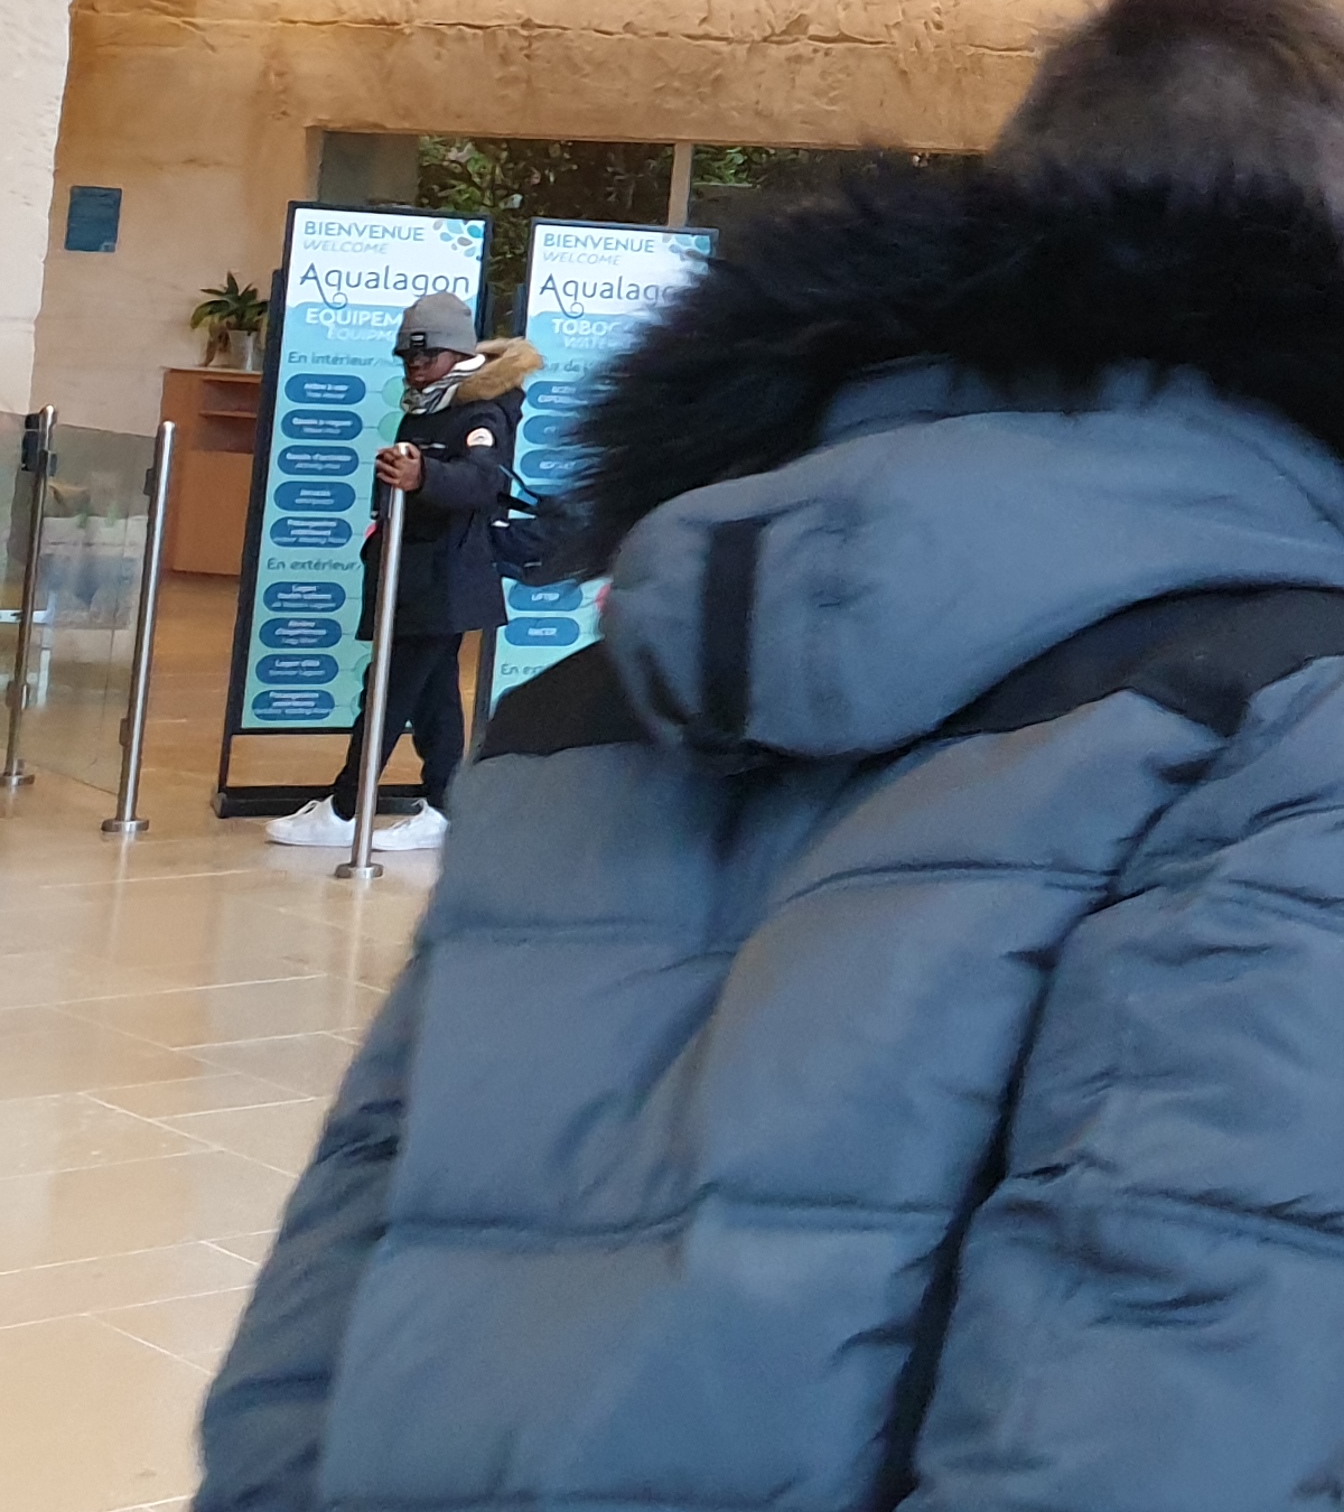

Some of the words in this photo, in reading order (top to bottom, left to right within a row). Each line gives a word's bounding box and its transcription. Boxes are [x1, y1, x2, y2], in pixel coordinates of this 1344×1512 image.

[303, 220, 425, 241] BIENVENUE
[303, 240, 388, 255] WELCOME
[543, 232, 655, 253] BIENVENUE
[543, 251, 621, 266] WELCOME
[300, 262, 469, 310] Aqualagon
[305, 307, 402, 328] EQUIPEM
[288, 352, 307, 365] En
[267, 558, 286, 571] En
